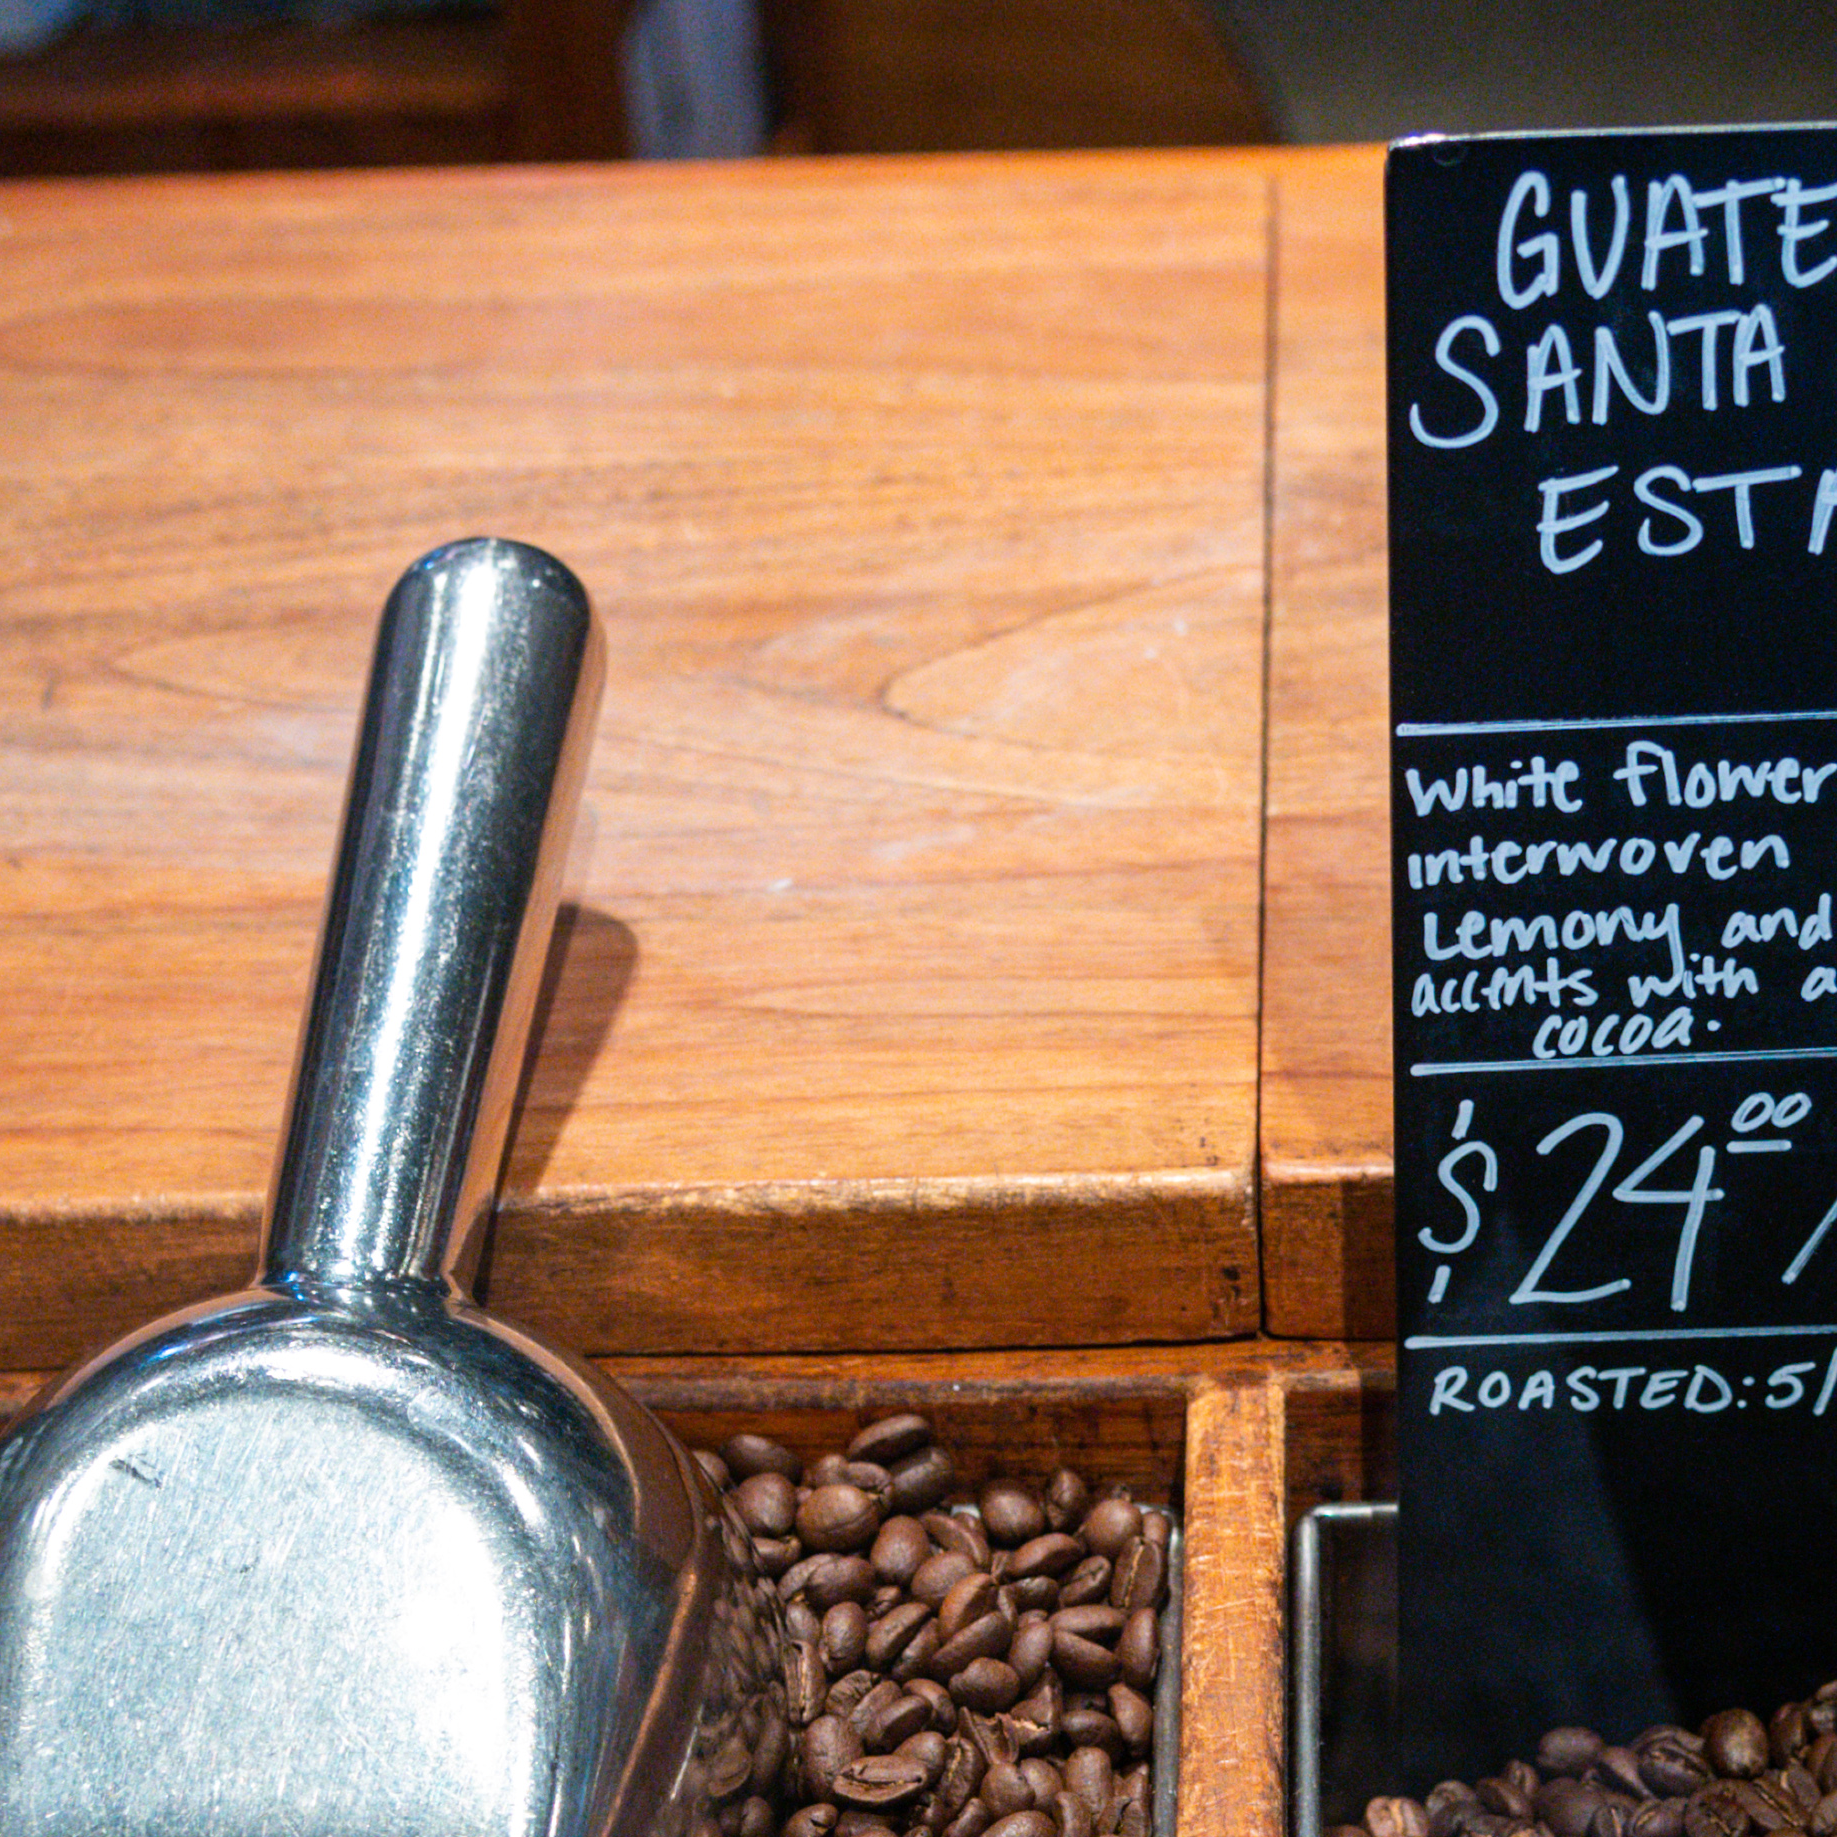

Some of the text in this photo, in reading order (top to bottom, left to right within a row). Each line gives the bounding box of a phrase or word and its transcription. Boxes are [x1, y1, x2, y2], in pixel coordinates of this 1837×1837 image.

[1410, 305, 1787, 448] SANTA
[1723, 894, 1832, 949] and
[1630, 953, 1759, 1000] with
[1802, 963, 1837, 1001] a
